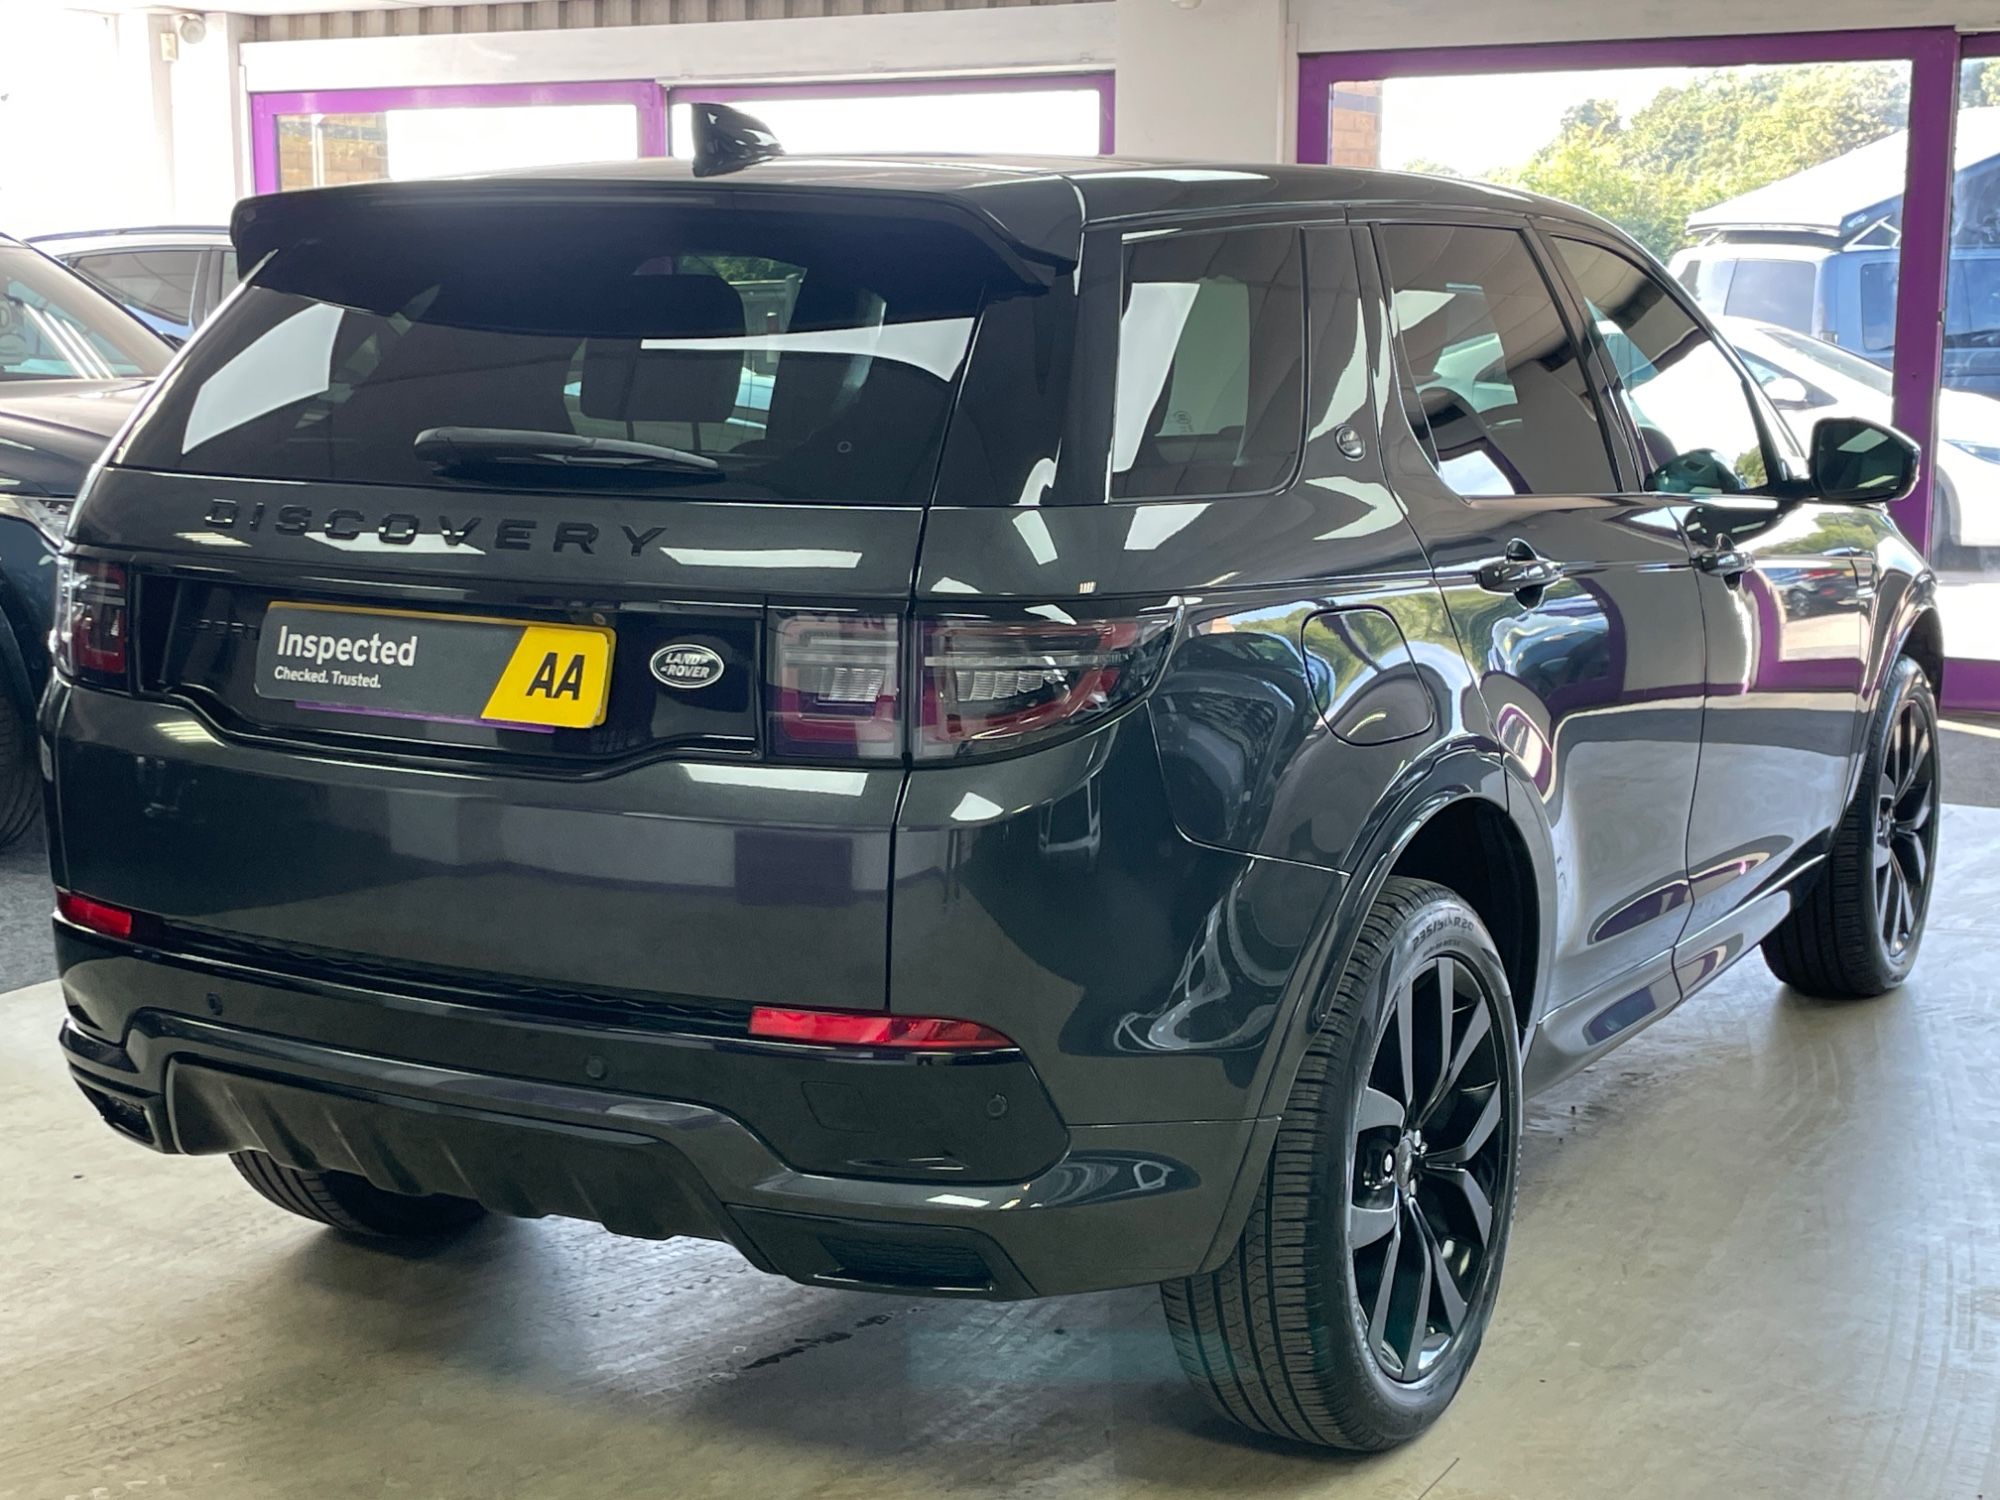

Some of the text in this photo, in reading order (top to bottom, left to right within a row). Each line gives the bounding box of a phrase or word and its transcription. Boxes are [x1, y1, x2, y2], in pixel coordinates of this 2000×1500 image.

[204, 498, 667, 557] DISCOVERY
[276, 625, 418, 667] Inspected
[665, 652, 701, 665] LAND
[274, 665, 382, 689] Checked. Trusted.
[525, 651, 586, 701] AA
[666, 664, 710, 678] ROVER
